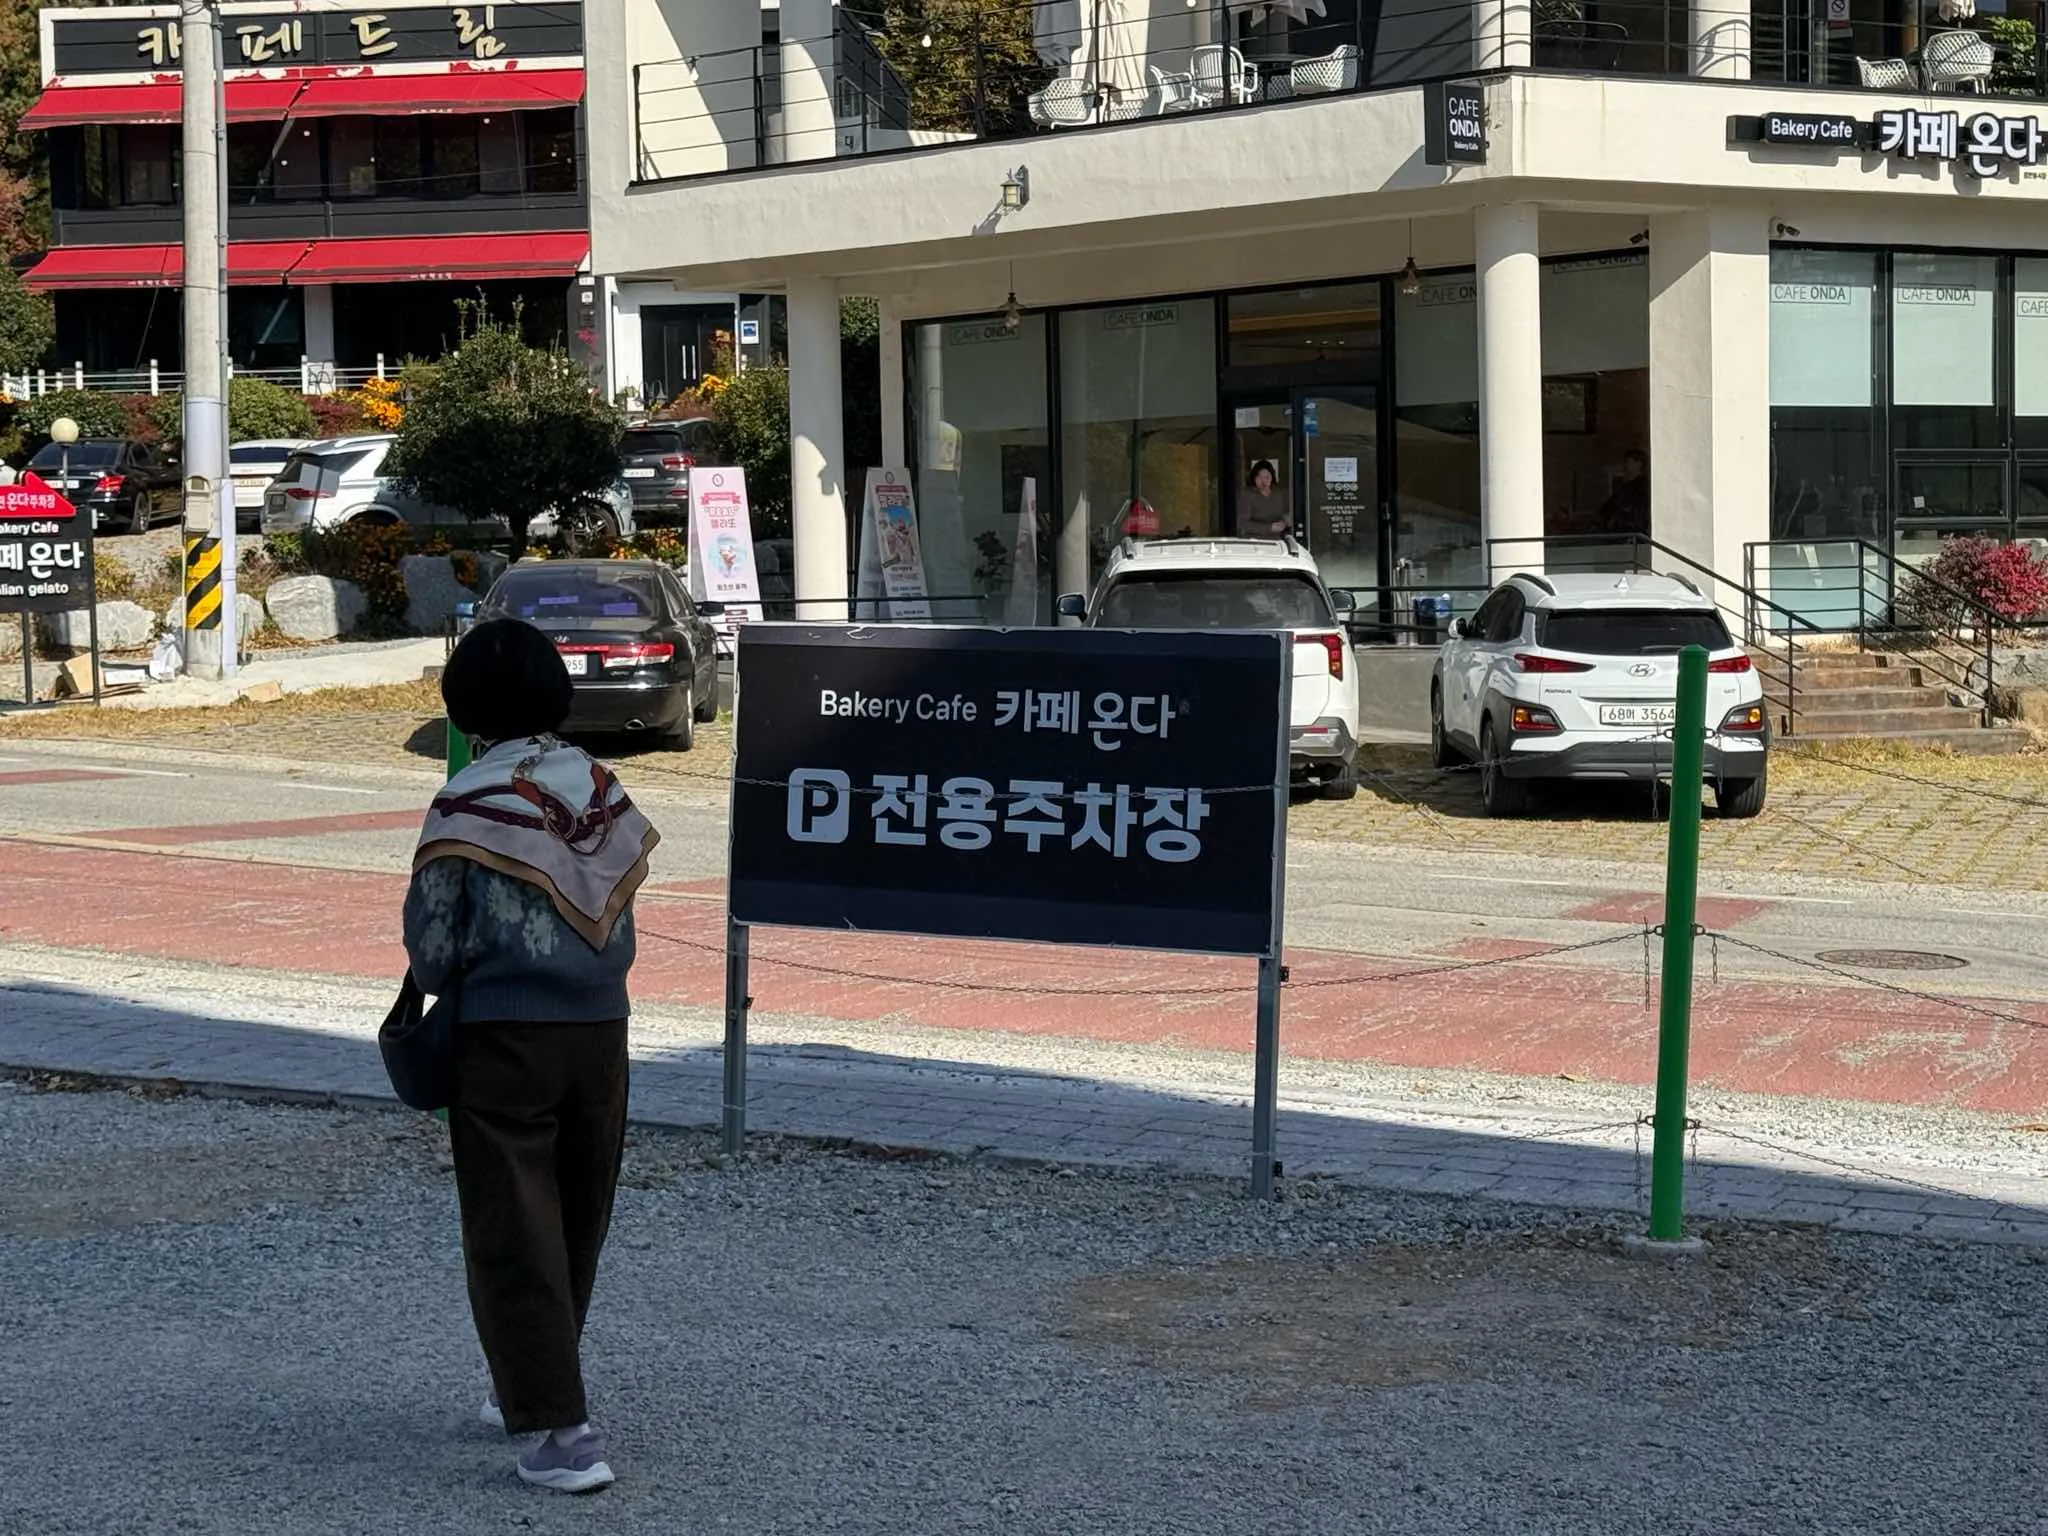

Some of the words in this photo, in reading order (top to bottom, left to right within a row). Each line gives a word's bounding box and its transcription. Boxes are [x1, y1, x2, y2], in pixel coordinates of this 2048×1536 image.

[1448, 97, 1480, 117] CAFE
[1449, 118, 1482, 138] ONDA
[1771, 117, 1825, 140] Bakery
[1821, 120, 1854, 139] Cafe
[1879, 111, 1956, 160] 카페
[1967, 114, 2043, 177] 온다
[1459, 285, 1477, 299] ON
[1774, 285, 1807, 301] CAFE
[1810, 285, 1846, 301] ONDA
[1902, 287, 1934, 302] CAFE
[1936, 287, 1971, 302] ONDA
[1141, 309, 1175, 323] ONDA
[0, 522, 30, 536] akery
[31, 521, 60, 534] Cafe
[0, 542, 23, 570] 페
[27, 541, 85, 580] 온다
[0, 583, 24, 596] lian
[28, 582, 70, 597] gelato
[565, 659, 584, 671] 955
[819, 689, 910, 724] Bakery
[915, 693, 978, 722] Cafe
[993, 688, 1081, 735] 카페
[1087, 691, 1176, 752] 온다
[1641, 707, 1674, 721] 3564
[870, 773, 1211, 864] 전용주차장
